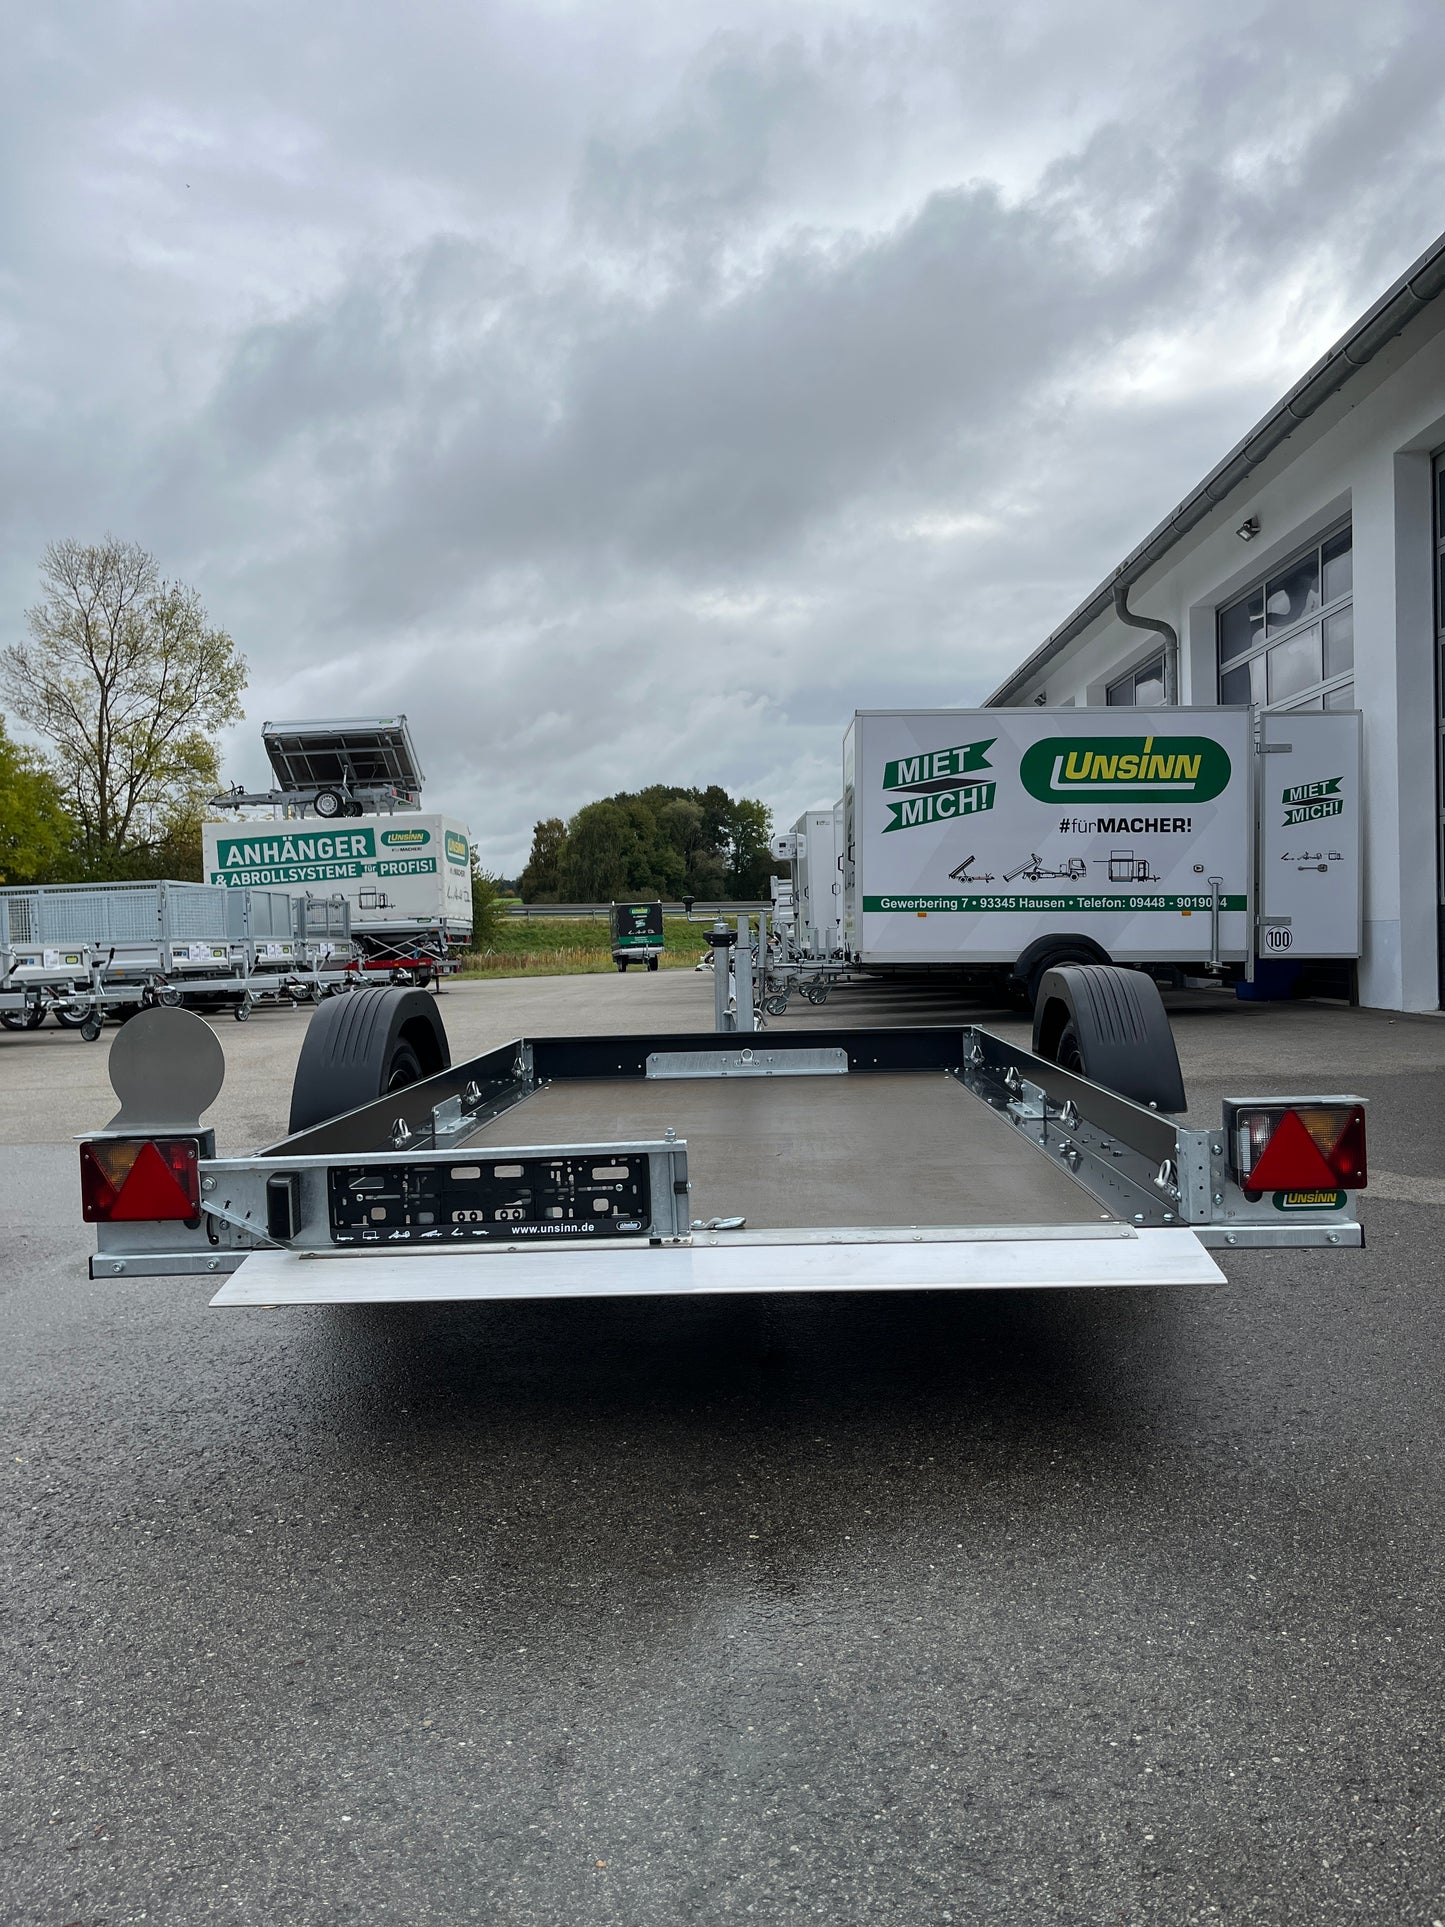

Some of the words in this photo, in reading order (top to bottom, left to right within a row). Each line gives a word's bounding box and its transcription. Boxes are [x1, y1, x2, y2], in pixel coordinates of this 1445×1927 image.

[897, 746, 971, 785] MIET
[1065, 736, 1202, 780] UNSINN
[1290, 781, 1330, 802] MIET
[901, 786, 987, 826] MICH!
[1291, 801, 1339, 823] MICH!
[1059, 817, 1192, 833] #fürMACHER!
[226, 835, 368, 867] ANHÄNGER
[215, 874, 227, 887] &
[230, 864, 357, 886] ABROLLSYSTEME
[364, 864, 377, 873] für
[380, 859, 434, 876] PROFIS!
[880, 898, 958, 910] Gewerbering
[961, 898, 969, 908] 7
[980, 898, 1016, 908] 93345
[1019, 898, 1065, 908] Hausen
[1077, 897, 1125, 908] Telefon:
[1129, 897, 1165, 908] 09448
[1177, 897, 1227, 908] 901904
[1268, 931, 1290, 947] 100
[1288, 1190, 1337, 1203] UNSINN
[511, 1222, 595, 1234] www.unsinn.de
